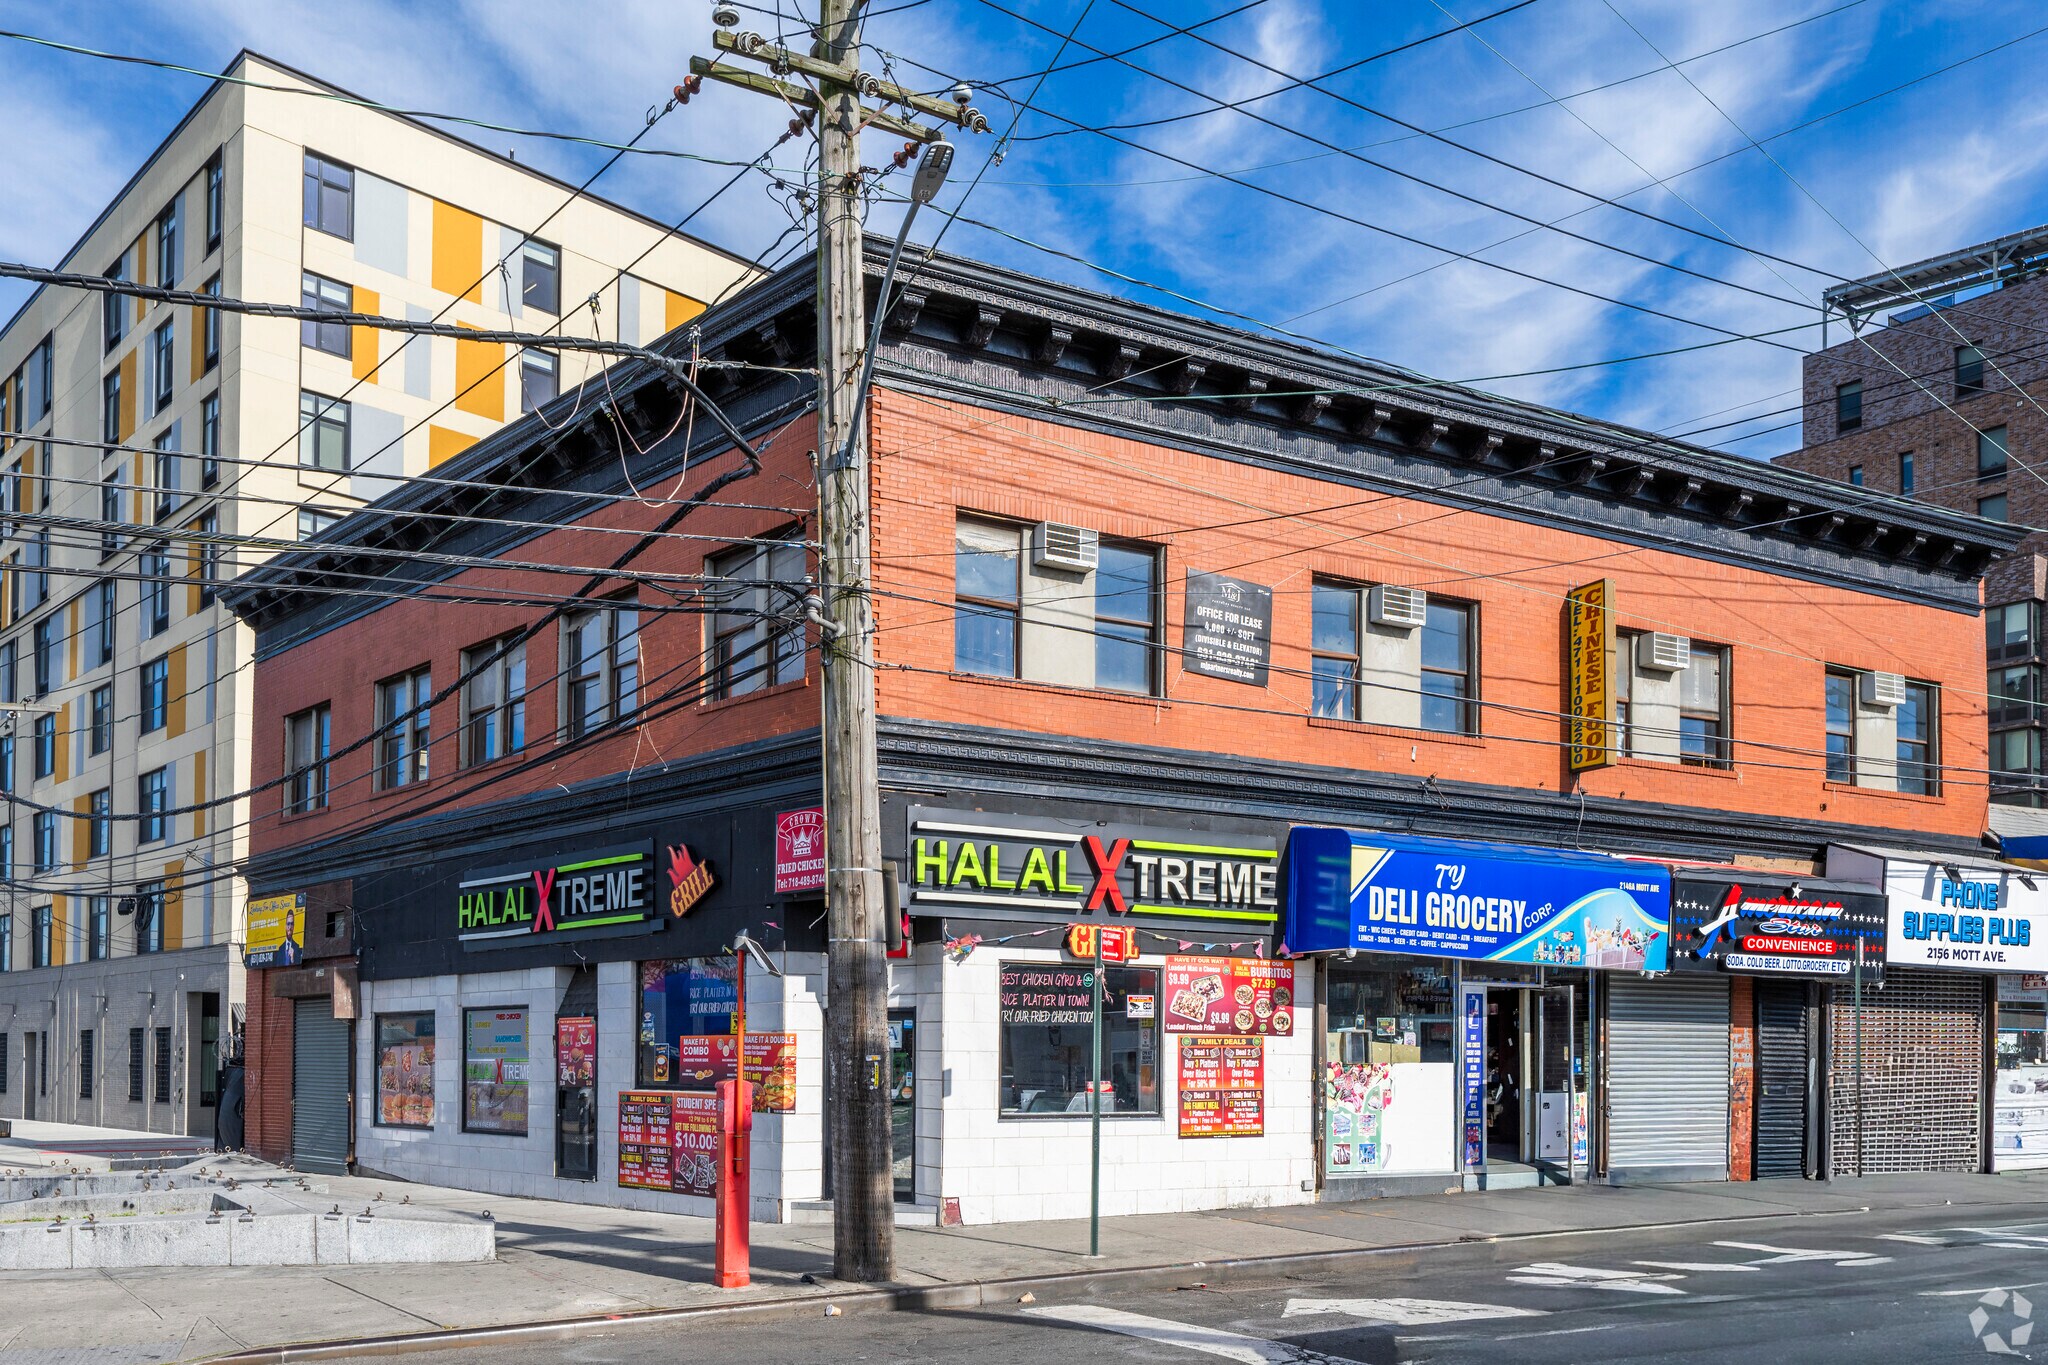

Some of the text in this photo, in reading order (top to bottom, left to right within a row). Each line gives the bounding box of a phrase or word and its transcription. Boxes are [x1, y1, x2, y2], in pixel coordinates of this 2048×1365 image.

[1197, 606, 1262, 630] OFFICE FOR LEASE
[1238, 630, 1256, 641] SQFT
[1584, 588, 1602, 695] CHINESE
[1195, 634, 1226, 648] (DIVISIBLE
[1233, 642, 1262, 656] ELEVATOR)
[1585, 700, 1603, 762] FOOD
[790, 813, 816, 827] CROWN
[778, 863, 796, 875] FRIED
[914, 836, 1278, 912] HALAL XTREME
[778, 879, 788, 888] Tel:
[1435, 864, 1466, 890] TY
[670, 860, 714, 917] GRILL
[1636, 882, 1650, 892] MOTT
[1650, 884, 1660, 892] AVE
[459, 868, 643, 932] HALAL XTREME
[1941, 879, 1998, 910] PHONE
[1369, 886, 1555, 934] DELI GROCERY CORP.
[1381, 927, 1396, 935] CHECK
[1400, 928, 1416, 936] CREDIT
[1474, 936, 1498, 944] BREAKFAST
[1903, 912, 2031, 946] SUPPLIES PLUS
[1420, 940, 1437, 948] COFFEE
[1747, 939, 1832, 952] CONVENIENCE
[1927, 948, 2006, 962] 2156 MOTT AVE.
[1727, 955, 1746, 967] SODA.
[1746, 957, 1764, 968] COLD
[1764, 958, 1782, 969] BEER.
[1168, 972, 1189, 985] $9.99
[1250, 967, 1292, 978] BURRITOS
[1002, 973, 1020, 986] BEST
[1022, 973, 1053, 986] CHICKEN
[1055, 973, 1074, 986] GYRO
[1252, 978, 1276, 988] $7.99
[1002, 993, 1018, 1006] RICE
[1022, 994, 1056, 1008] PLATTER
[1058, 994, 1066, 1006] IN
[1002, 1009, 1094, 1023] TRY OUR FRIED CHICKEN TOO!
[1211, 1012, 1230, 1024] $9.99
[770, 1036, 794, 1044] DOUBLE
[683, 1046, 709, 1055] COMBO
[1185, 1059, 1218, 1069] Buy 3 Platters
[1227, 1059, 1259, 1069] Buy 5 Platters
[1183, 1070, 1194, 1078] Over
[1196, 1070, 1206, 1078] Rice
[1232, 1070, 1254, 1078] Over Rice
[1231, 1080, 1240, 1088] Get
[676, 1097, 716, 1110] STUDENT SPE
[690, 1124, 711, 1133] FOLLOWING
[675, 1131, 712, 1150] $10.00
